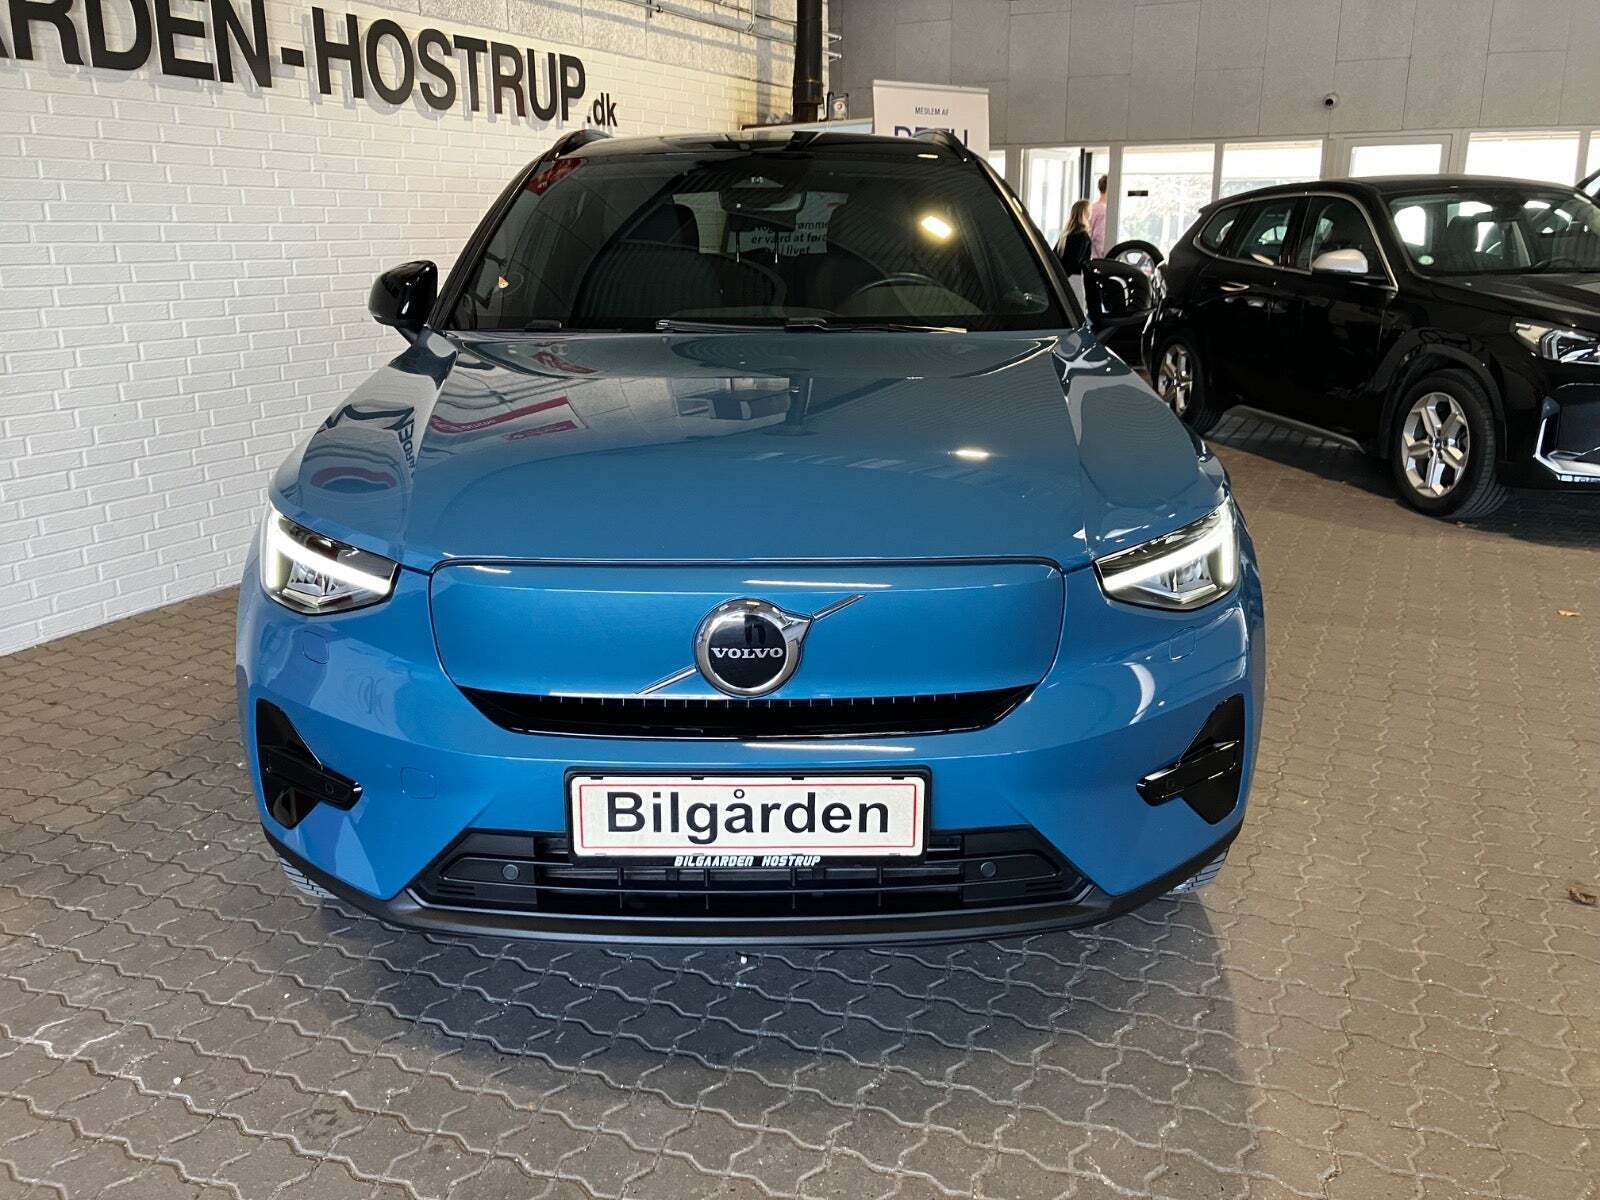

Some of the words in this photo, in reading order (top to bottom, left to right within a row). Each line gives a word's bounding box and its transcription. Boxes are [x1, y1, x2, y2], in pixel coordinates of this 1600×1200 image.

[0, 0, 618, 127] RDEN-HOSTRUP.dk
[711, 647, 784, 660] VOLVO
[606, 788, 889, 845] Bilgården
[673, 855, 755, 867] BILGAARDEN
[761, 855, 821, 867] HOSTRUP
